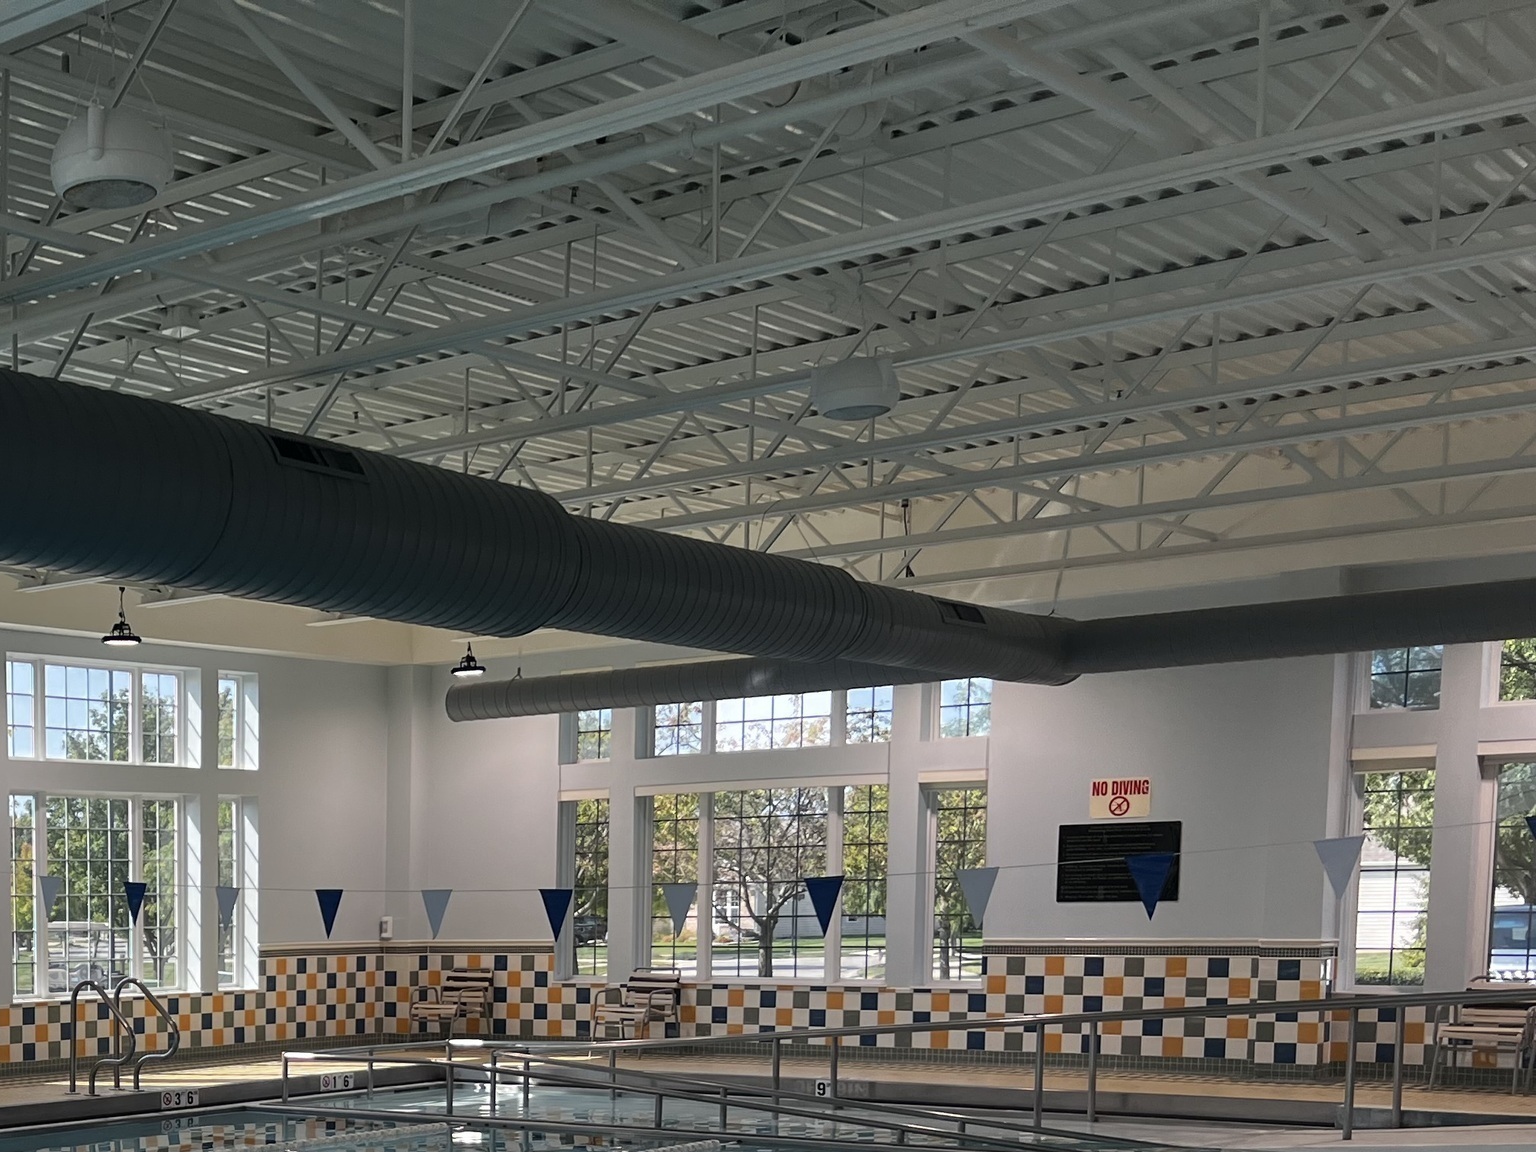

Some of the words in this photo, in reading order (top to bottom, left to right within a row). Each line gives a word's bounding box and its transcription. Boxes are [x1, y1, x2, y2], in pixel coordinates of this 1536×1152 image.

[1092, 781, 1108, 796] NO
[1111, 780, 1149, 796] DIVING
[344, 1075, 349, 1087] 6
[817, 1082, 825, 1096] 9
[175, 1092, 181, 1105] 3
[187, 1091, 193, 1104] 6
